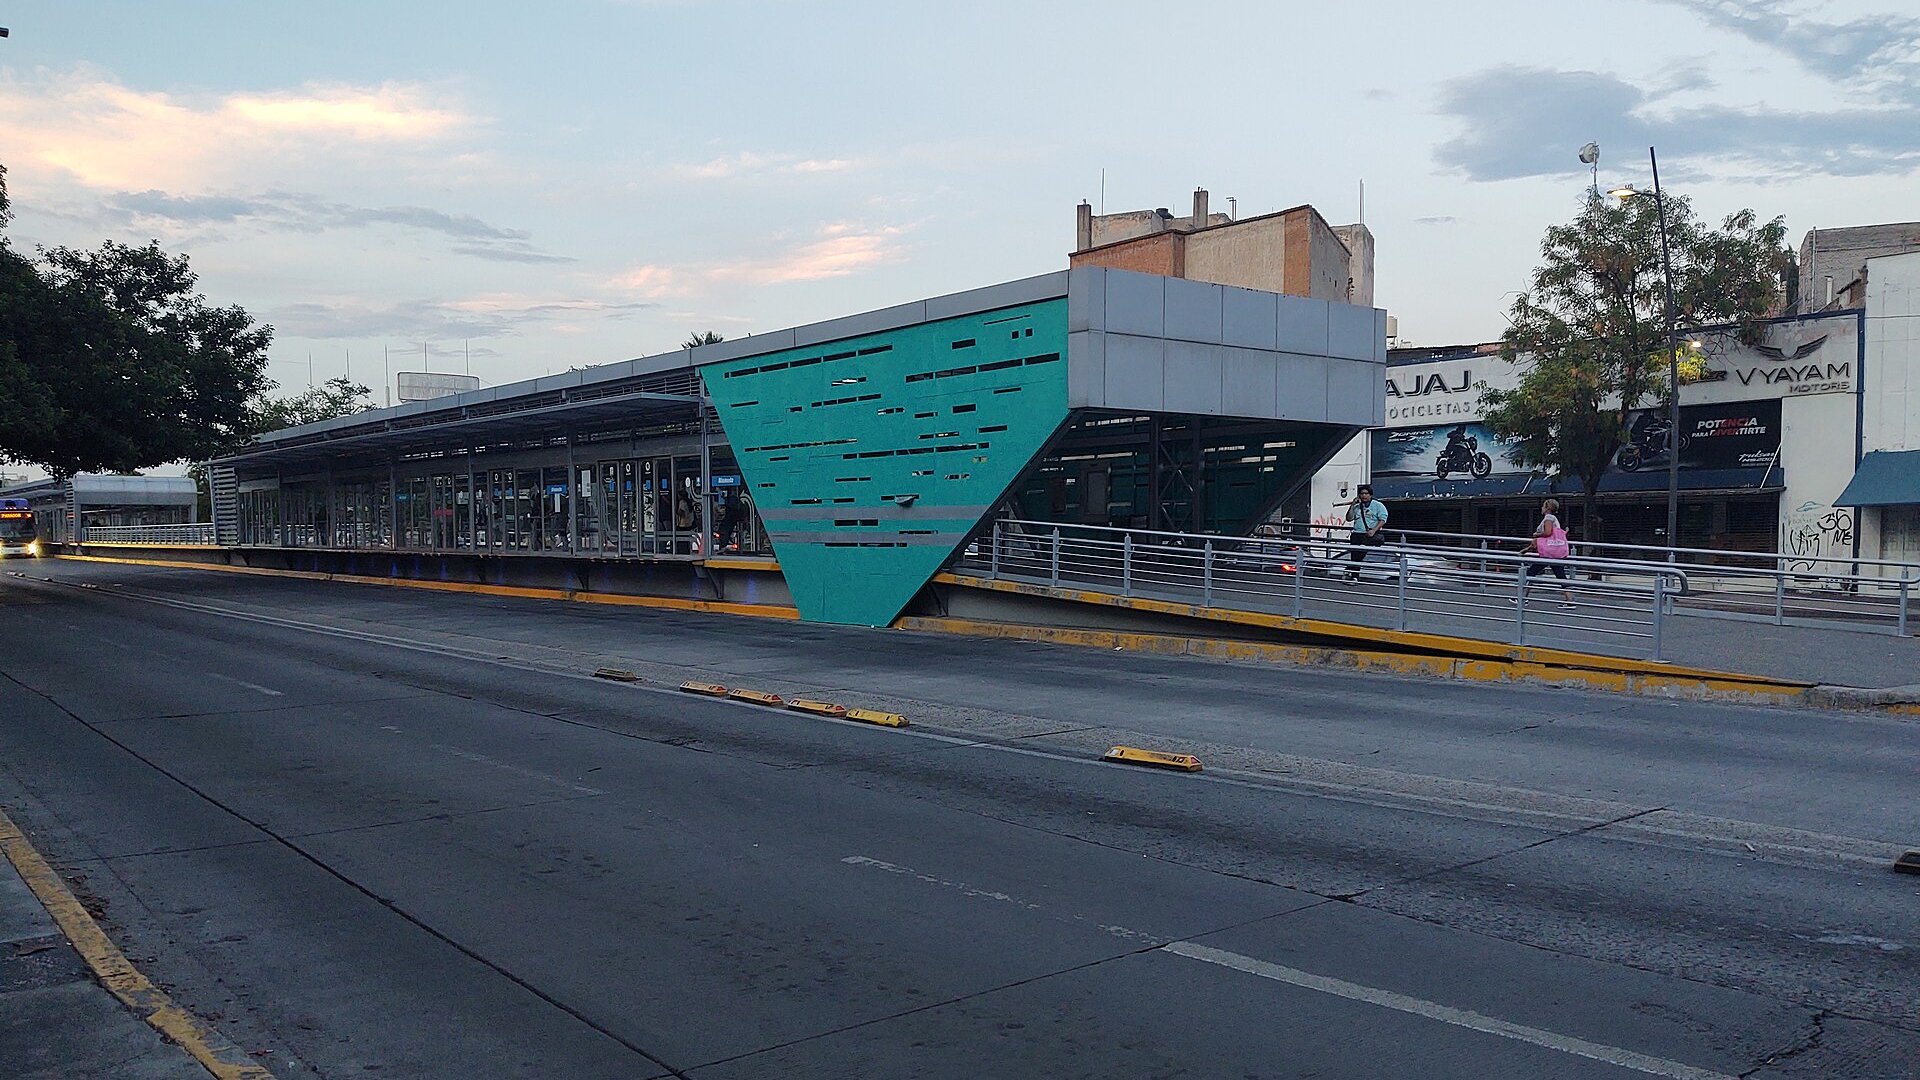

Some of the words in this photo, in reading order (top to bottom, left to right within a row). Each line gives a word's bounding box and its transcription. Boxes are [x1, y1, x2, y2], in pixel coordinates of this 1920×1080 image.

[1736, 362, 1850, 386] VYAYAM
[1386, 370, 1471, 398] AJAJ
[1790, 381, 1850, 393] MOTORS
[1389, 401, 1470, 419] OCICLETAS
[1697, 417, 1758, 429] POTENCIA
